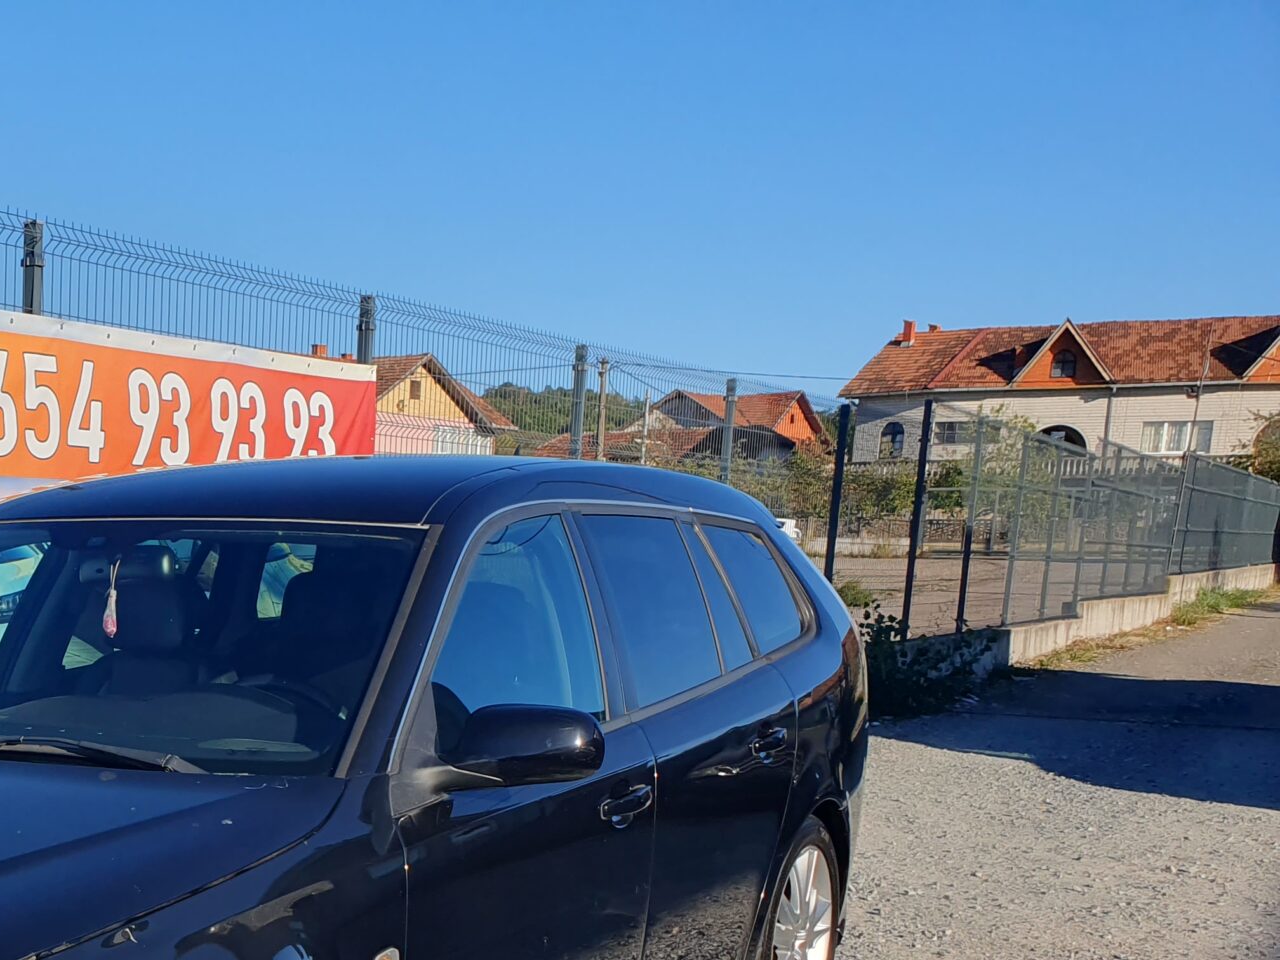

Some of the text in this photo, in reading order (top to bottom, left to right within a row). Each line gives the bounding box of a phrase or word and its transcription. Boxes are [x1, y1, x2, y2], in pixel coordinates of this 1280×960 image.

[127, 367, 191, 467] 93
[209, 377, 267, 463] 93
[283, 387, 336, 458] 93
